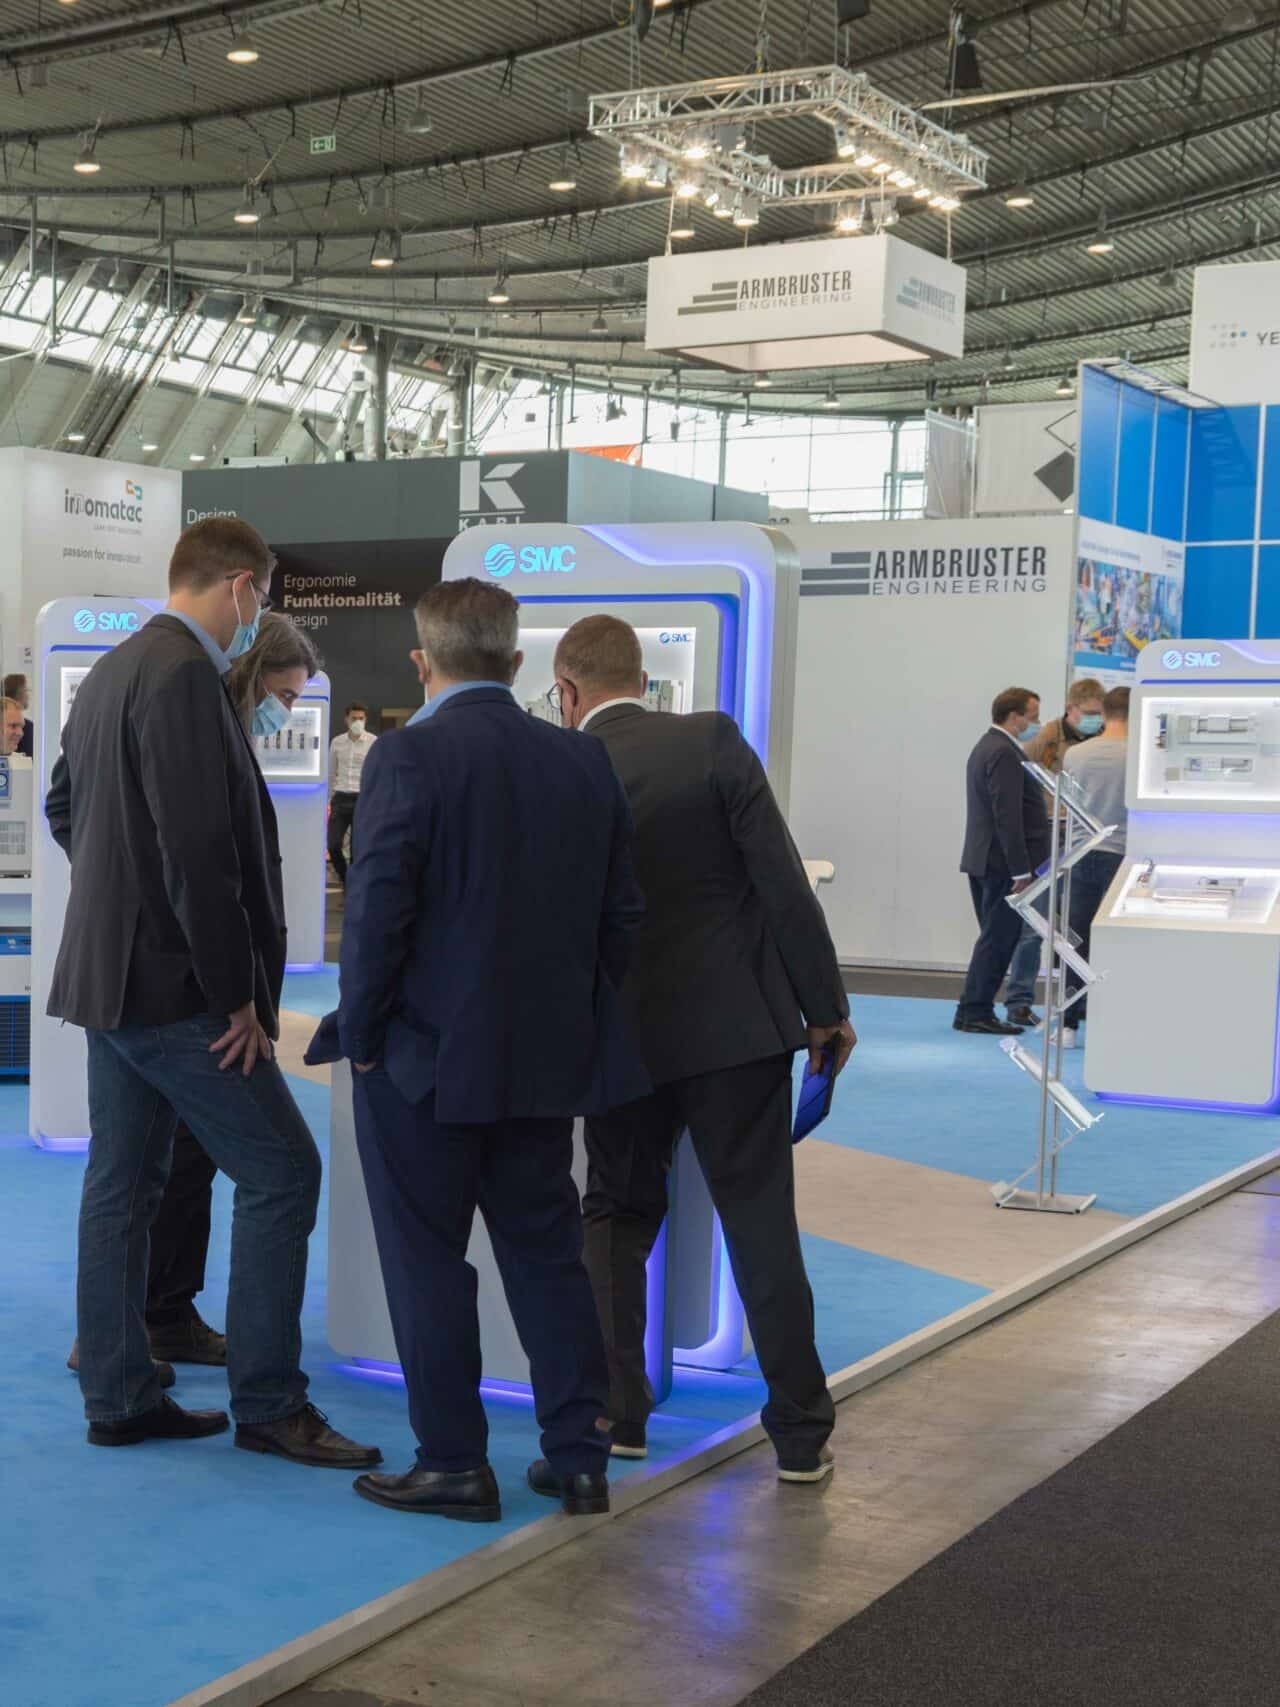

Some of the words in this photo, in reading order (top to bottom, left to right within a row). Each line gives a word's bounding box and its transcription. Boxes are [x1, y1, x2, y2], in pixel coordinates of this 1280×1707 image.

[739, 269, 852, 300] ARMBRUSTER
[738, 292, 852, 312] ENGINEERING
[519, 544, 577, 574] SMC
[873, 546, 1047, 579] ARMBRUSTER
[283, 573, 358, 591] Ergonomie
[872, 578, 1047, 596] ENGINEERING
[283, 591, 402, 609] Funktionalität
[98, 611, 139, 631] SMC
[1184, 651, 1221, 668] SMC
